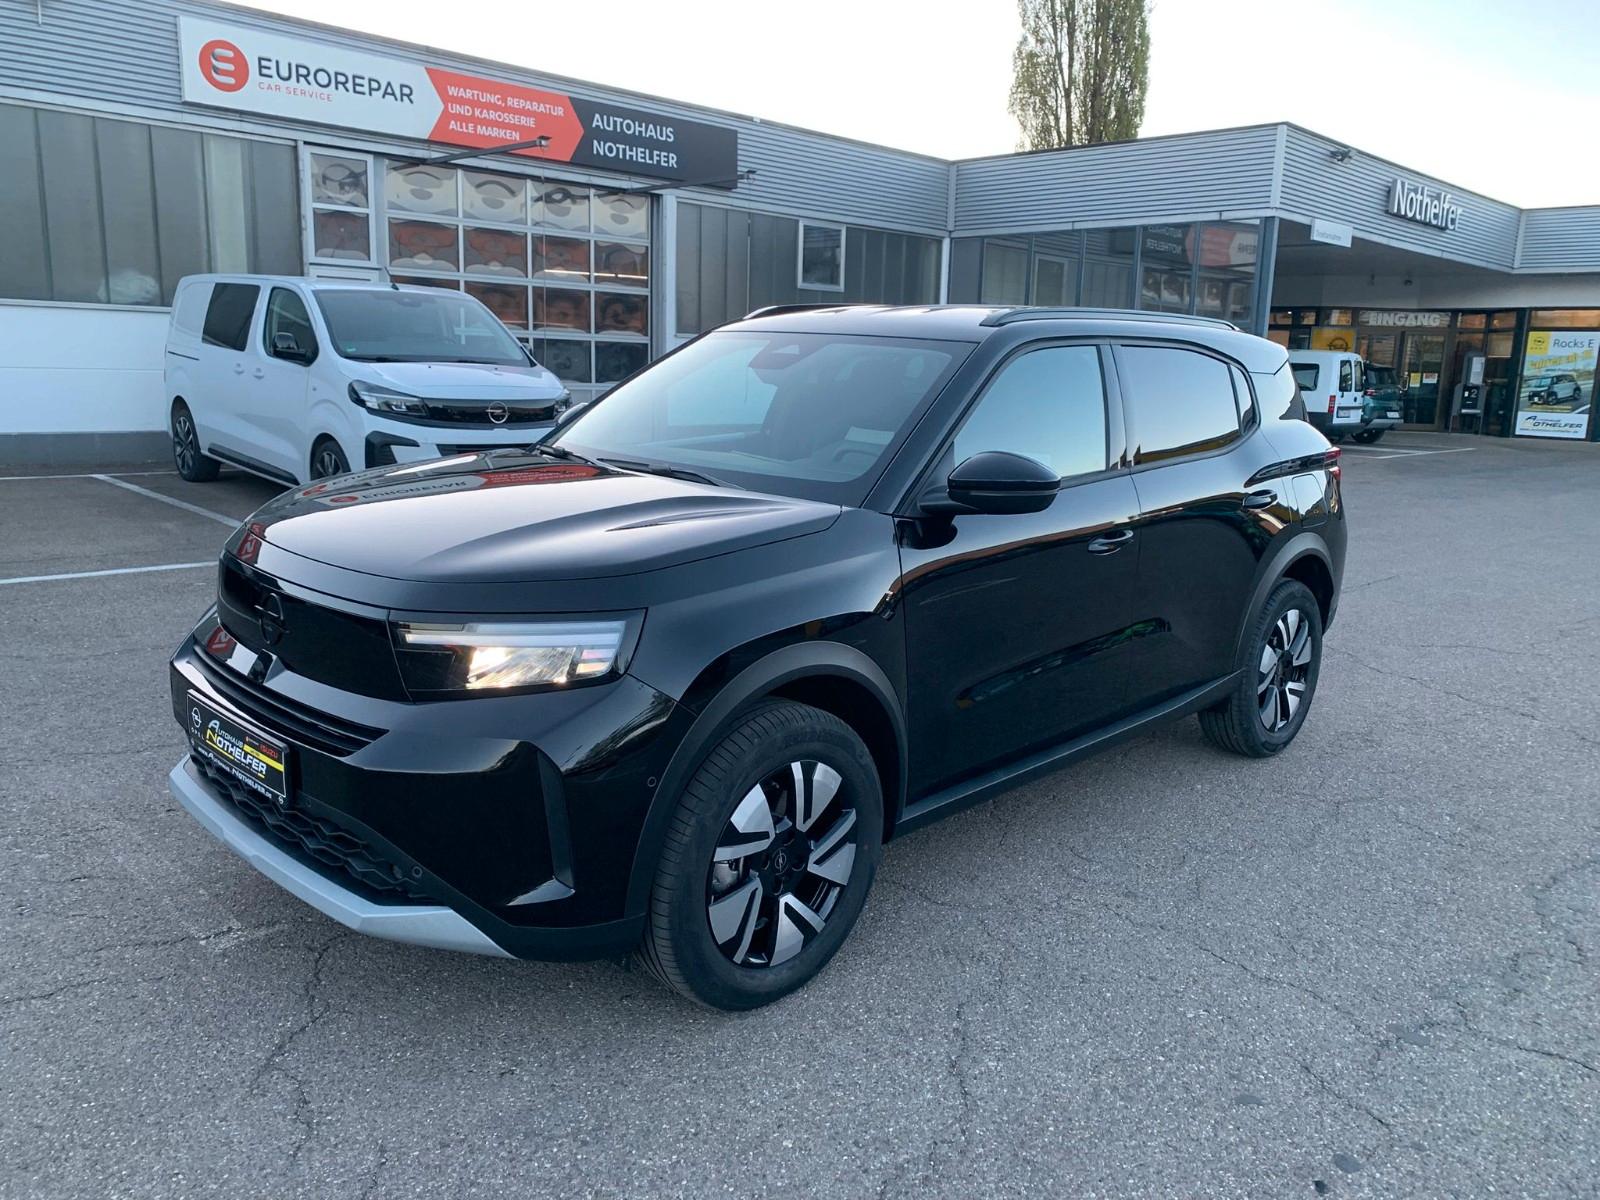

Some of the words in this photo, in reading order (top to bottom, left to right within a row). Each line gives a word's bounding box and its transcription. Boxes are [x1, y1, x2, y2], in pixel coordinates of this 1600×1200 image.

[257, 56, 414, 104] EUROREPAR
[258, 81, 282, 93] CAR
[285, 87, 334, 102] SERVICE
[447, 85, 505, 107] WARTUNG,
[506, 96, 565, 117] REPARATUR
[447, 103, 473, 116] UND
[474, 107, 536, 128] KAROSSERIE
[449, 120, 475, 134] ALLE
[476, 125, 520, 141] MARKEN
[592, 113, 675, 143] AUTOHAUS
[592, 139, 678, 169] NOTHELFER
[1390, 178, 1463, 232] Nothelfer
[1368, 311, 1441, 327] EINGANG
[1552, 338, 1585, 349] Rocks
[206, 728, 267, 775] NOTHELFER
